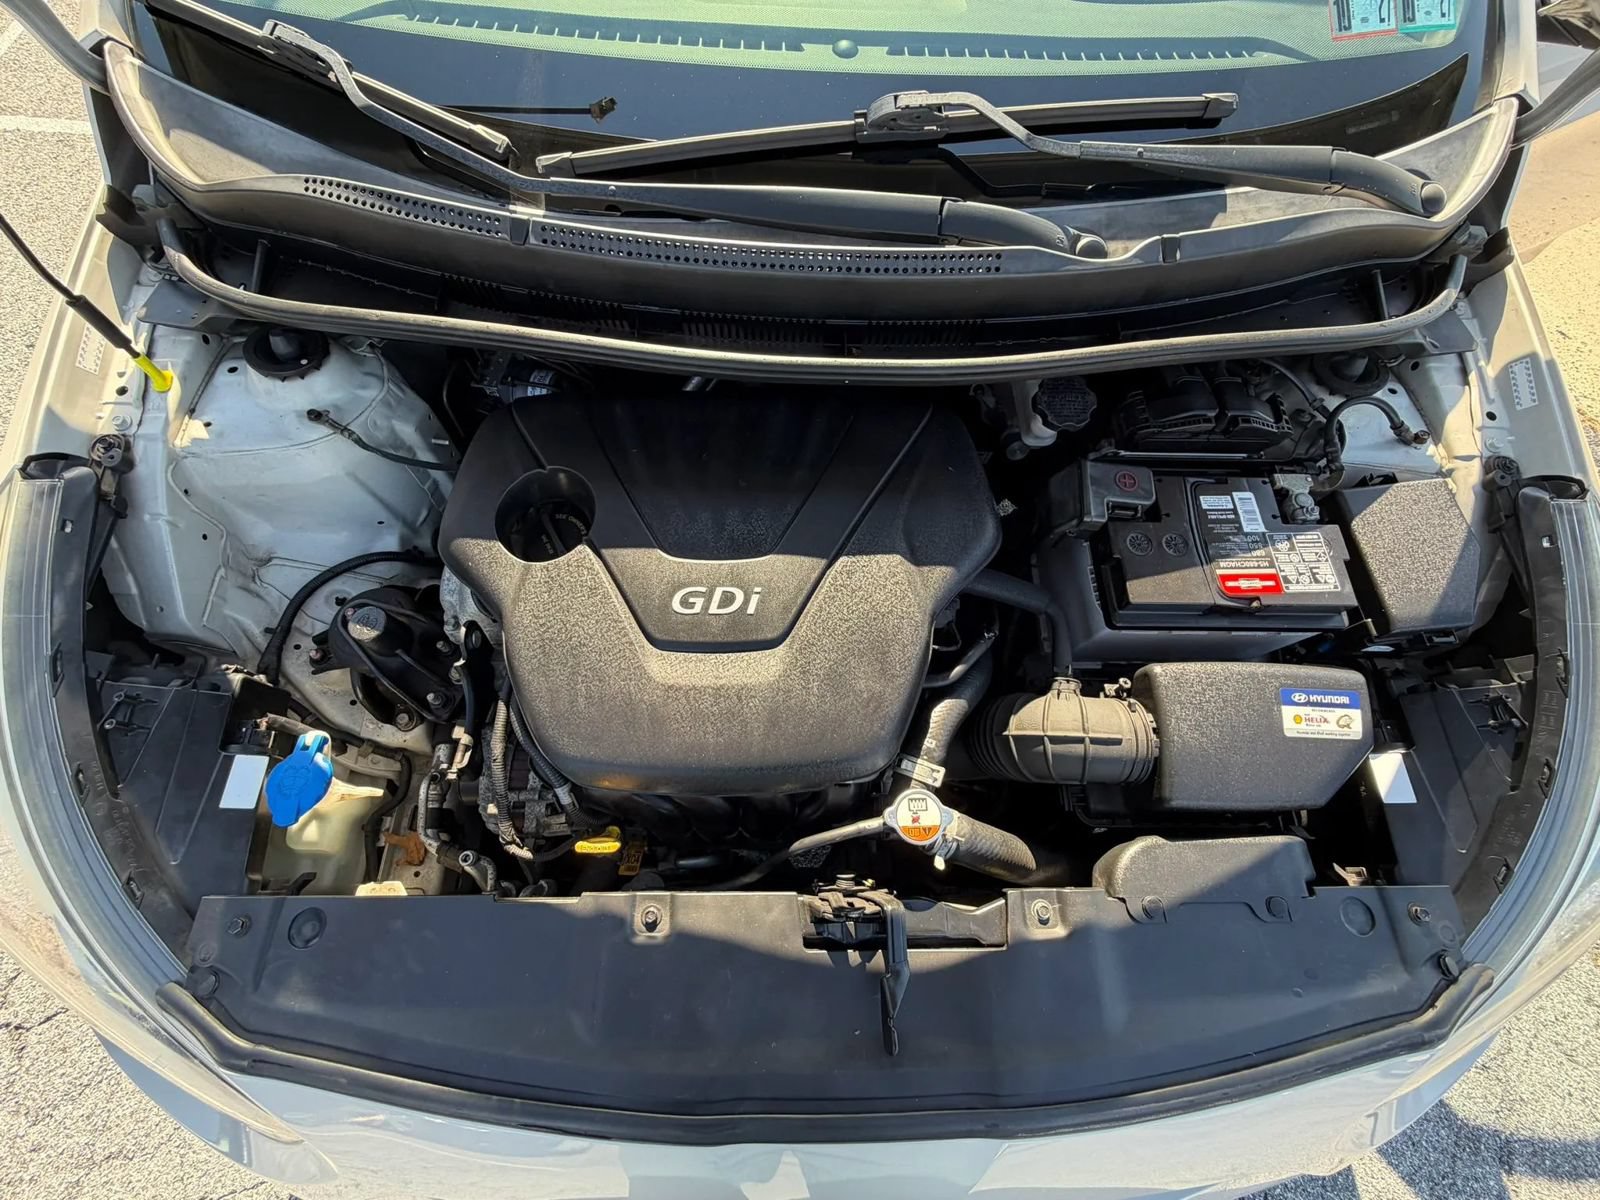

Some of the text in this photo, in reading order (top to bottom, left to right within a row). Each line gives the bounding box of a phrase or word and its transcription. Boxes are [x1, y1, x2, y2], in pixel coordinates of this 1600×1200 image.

[671, 586, 762, 615] GDi
[1309, 694, 1350, 704] HYUNDAI
[1304, 716, 1329, 724] HELIX
